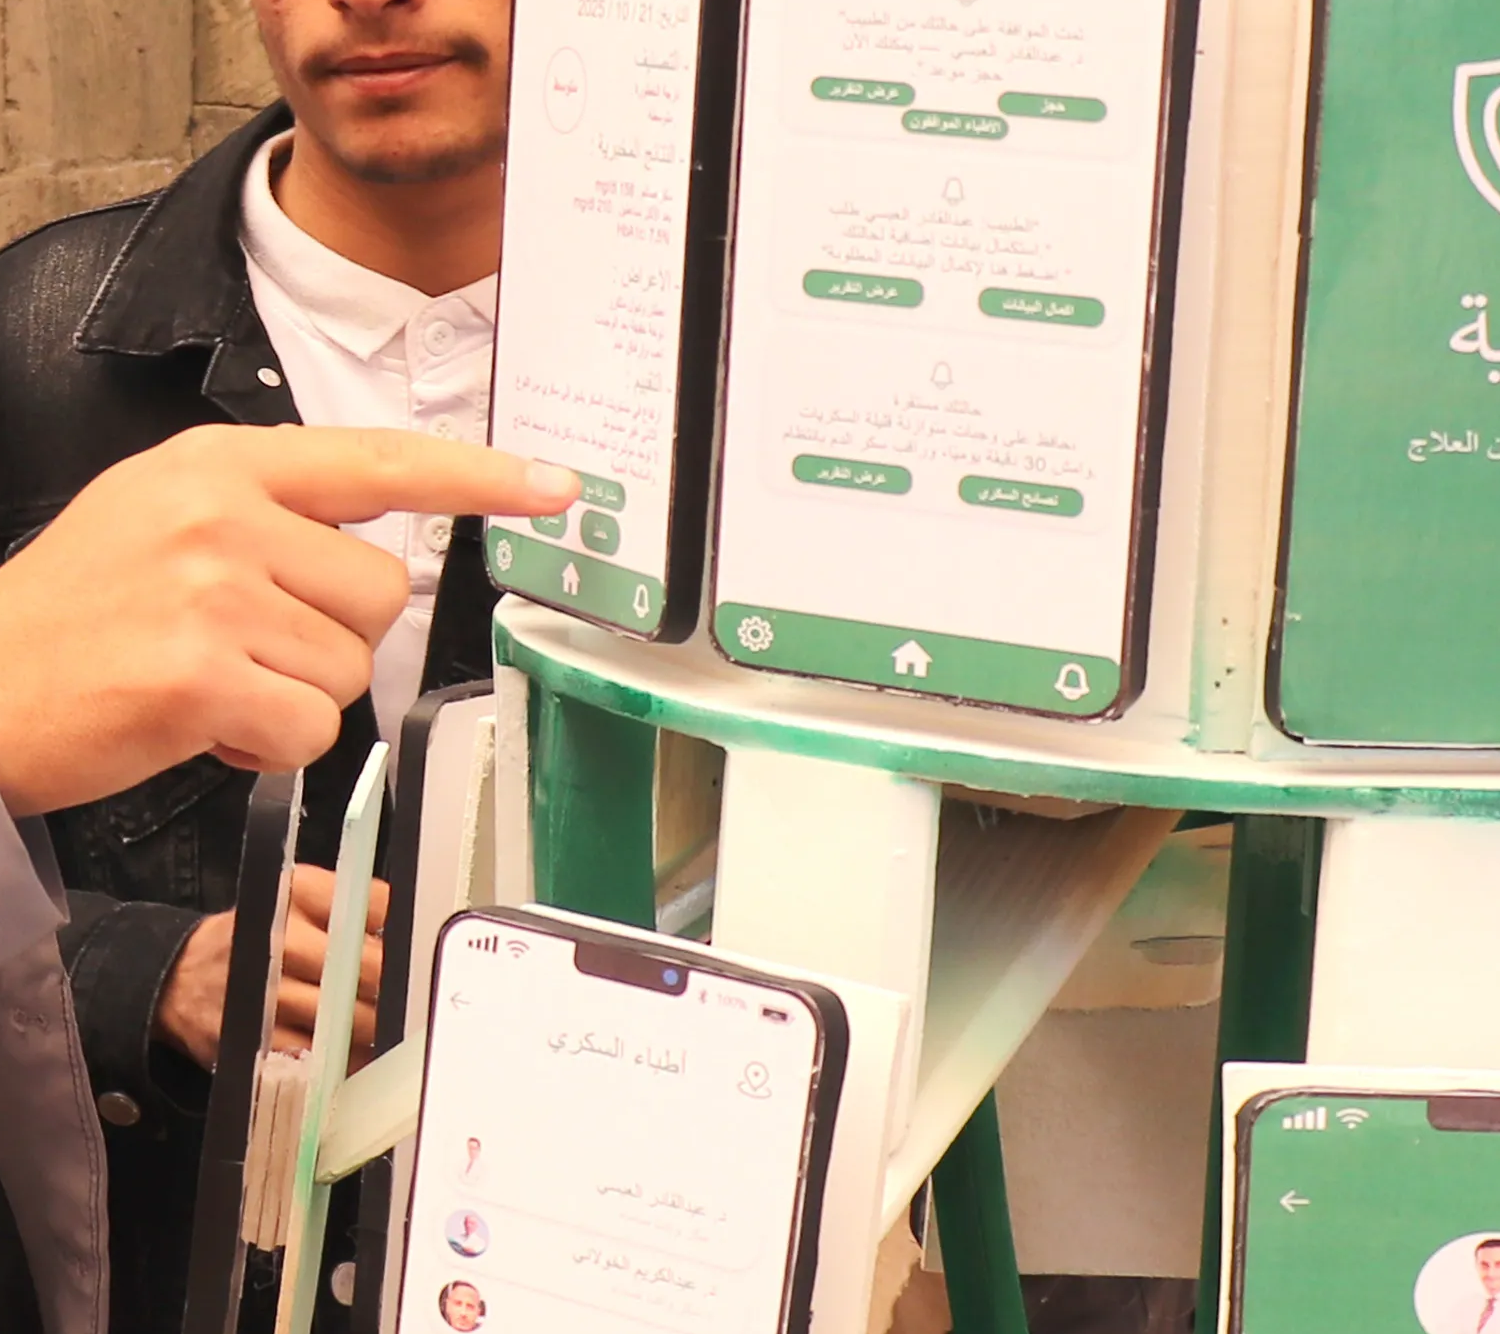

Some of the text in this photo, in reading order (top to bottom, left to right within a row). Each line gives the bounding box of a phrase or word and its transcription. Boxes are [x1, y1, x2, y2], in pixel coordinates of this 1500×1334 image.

[896, 18, 916, 31] من
[964, 19, 992, 38] على
[867, 83, 901, 101] عرض
[866, 284, 899, 301] عرض
[1406, 428, 1480, 464] العلاج
[1023, 454, 1047, 473] 30
[855, 467, 888, 487] عرض
[547, 1030, 626, 1061] السكري
